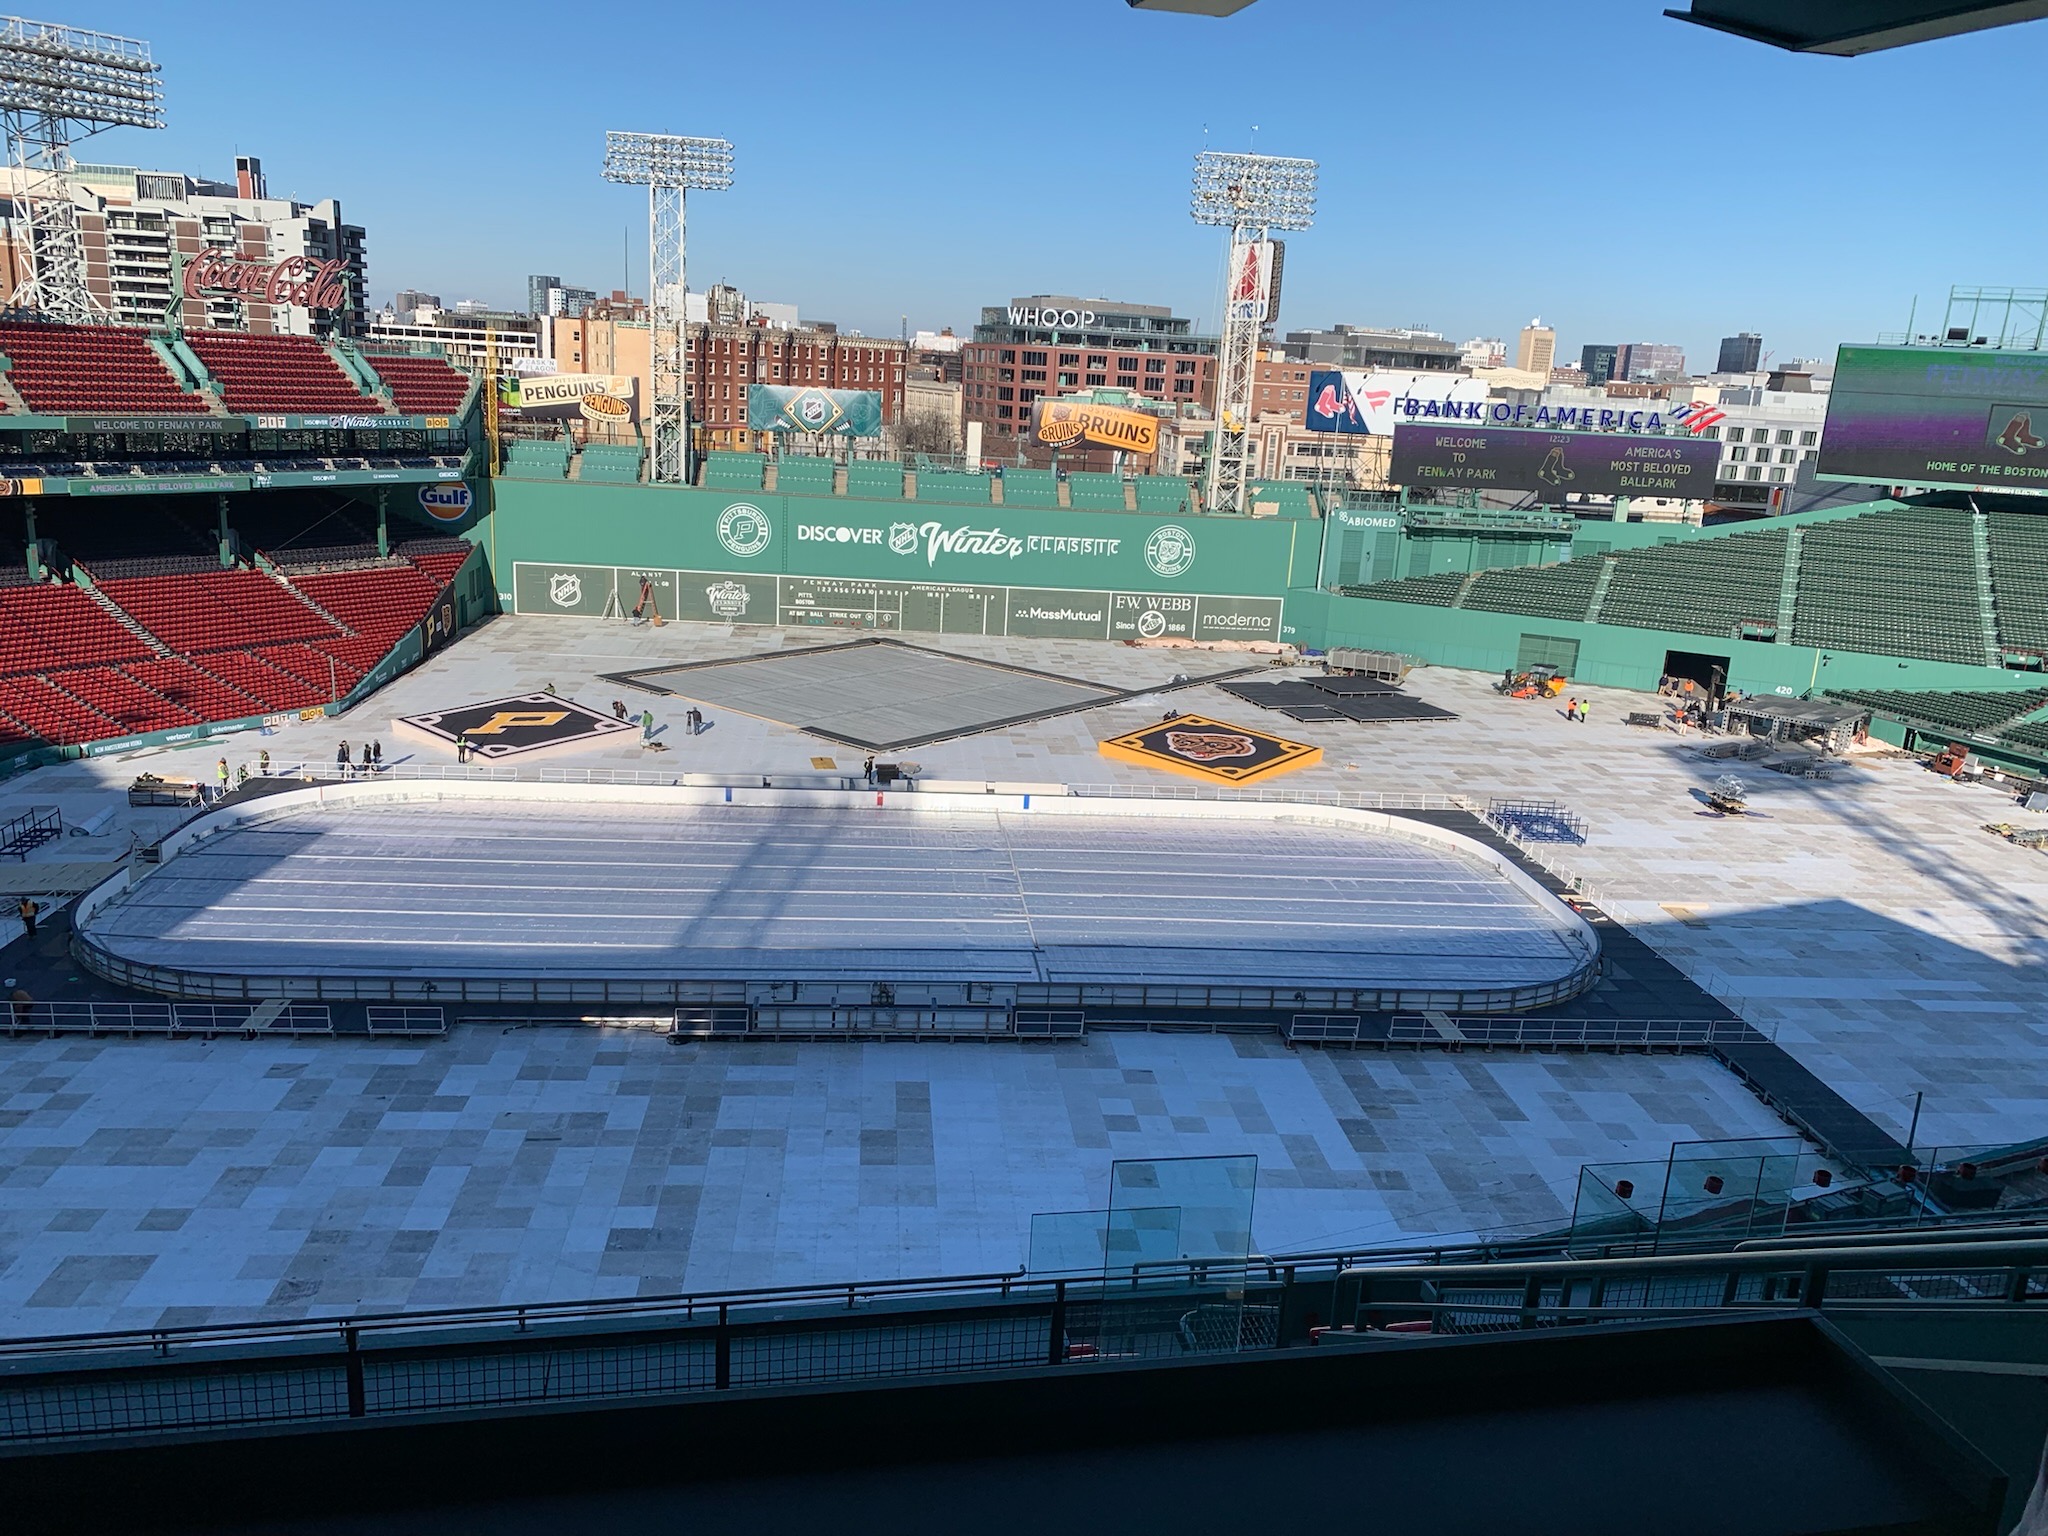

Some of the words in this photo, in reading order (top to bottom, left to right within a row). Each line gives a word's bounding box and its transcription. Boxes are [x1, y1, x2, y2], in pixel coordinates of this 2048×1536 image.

[1007, 307, 1095, 329] WHOOP
[525, 381, 606, 400] PENGUINS
[584, 394, 628, 415] PENGUINS
[583, 407, 627, 421] PITTSBURGH
[1081, 405, 1120, 418] BOSTON
[1405, 398, 1484, 420] BANK
[1492, 404, 1529, 422] OF
[1535, 404, 1663, 429] AMERICA
[94, 421, 139, 430] WELCOME
[143, 421, 155, 430] TO
[158, 421, 195, 430] FENWAY
[199, 421, 223, 430] PARK
[259, 417, 285, 428] PIT
[340, 415, 377, 429] Winter
[426, 418, 449, 428] BOS
[1079, 413, 1151, 444] BRUINS
[1041, 422, 1080, 440] BRUINS
[1435, 437, 1487, 449] WELCOME
[1549, 436, 1571, 444] 12:23
[1453, 452, 1466, 463] TO
[1625, 447, 1682, 459] AMERICA'S
[1417, 466, 1463, 478] FENWAY
[1466, 468, 1496, 480] PARK
[1611, 460, 1639, 473] MOST
[1643, 462, 1691, 475] BELOVED
[1927, 461, 1957, 472] HOME
[1960, 463, 1976, 473] OF
[1980, 464, 2001, 475] THE
[2004, 466, 2048, 478] BOSTON
[90, 483, 133, 492] AMERICA'S
[135, 483, 157, 491] MOST
[159, 481, 193, 490] BELOVED
[195, 480, 234, 489] BALLPARK
[1620, 476, 1677, 489] BALLPARK
[421, 488, 468, 505] Gulf
[723, 508, 764, 525] PITTSBURGH
[1346, 517, 1396, 528] ABIOMED
[1157, 530, 1185, 541] BOSTON
[797, 525, 883, 545] DISCOVER
[919, 521, 1023, 568] Winter
[1028, 536, 1121, 555] CLASSIC
[706, 586, 751, 606] Winter
[1145, 597, 1191, 611] WEBB
[1030, 607, 1101, 622] MassMutual
[1203, 613, 1272, 627] moderna
[1116, 621, 1135, 630] Since
[1168, 624, 1186, 632] 1866
[1283, 625, 1295, 634] 379
[1775, 685, 1793, 695] 420
[264, 715, 287, 726] PIT
[301, 710, 324, 720] BOS
[212, 723, 245, 733] ticketmaster
[166, 732, 191, 741] verizon
